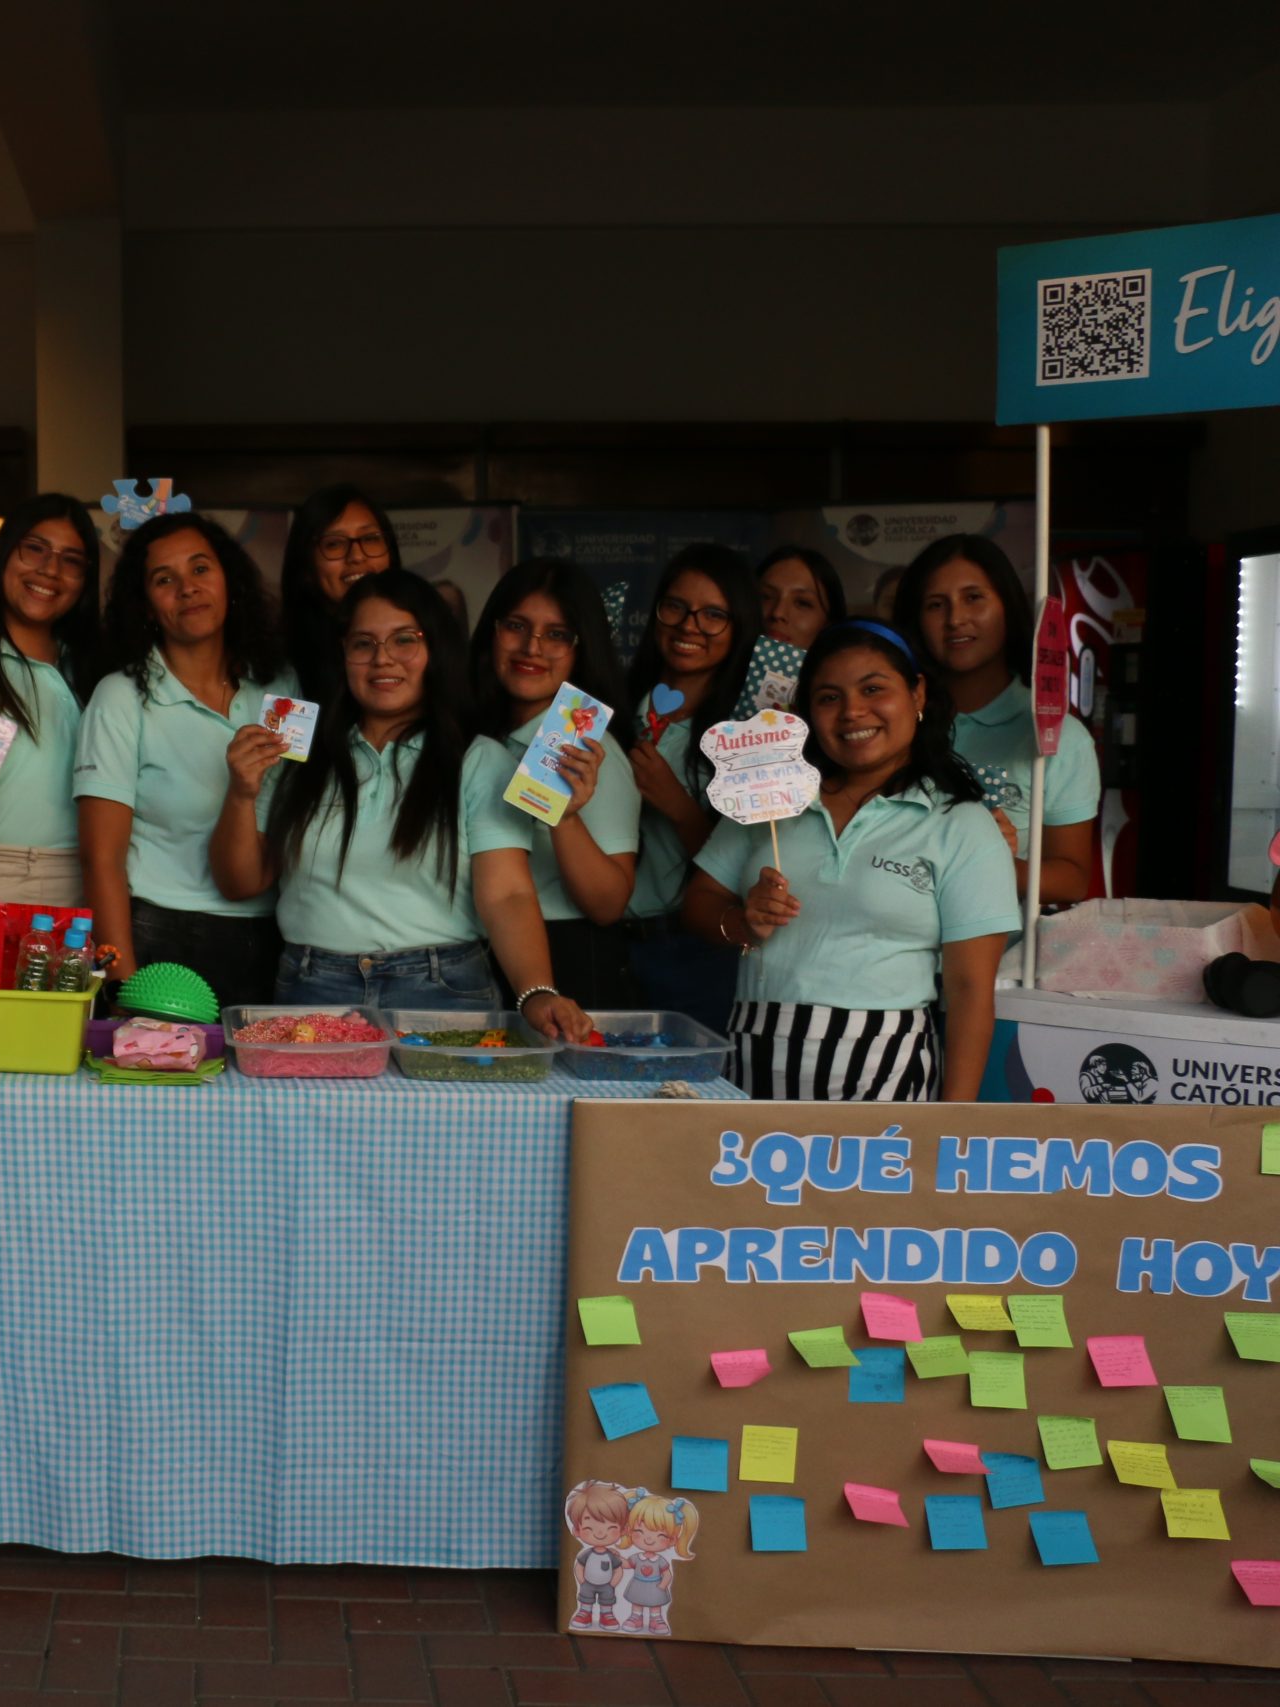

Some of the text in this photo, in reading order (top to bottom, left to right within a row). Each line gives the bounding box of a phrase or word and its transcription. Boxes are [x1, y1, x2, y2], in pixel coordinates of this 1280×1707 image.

[714, 729, 791, 752] Autismo
[723, 784, 815, 812] DIFERENTES
[871, 856, 911, 878] UCSS
[711, 1125, 1223, 1205] ¿QUÉ HEMOS
[617, 1226, 1280, 1302] APRENDIDO HOY
